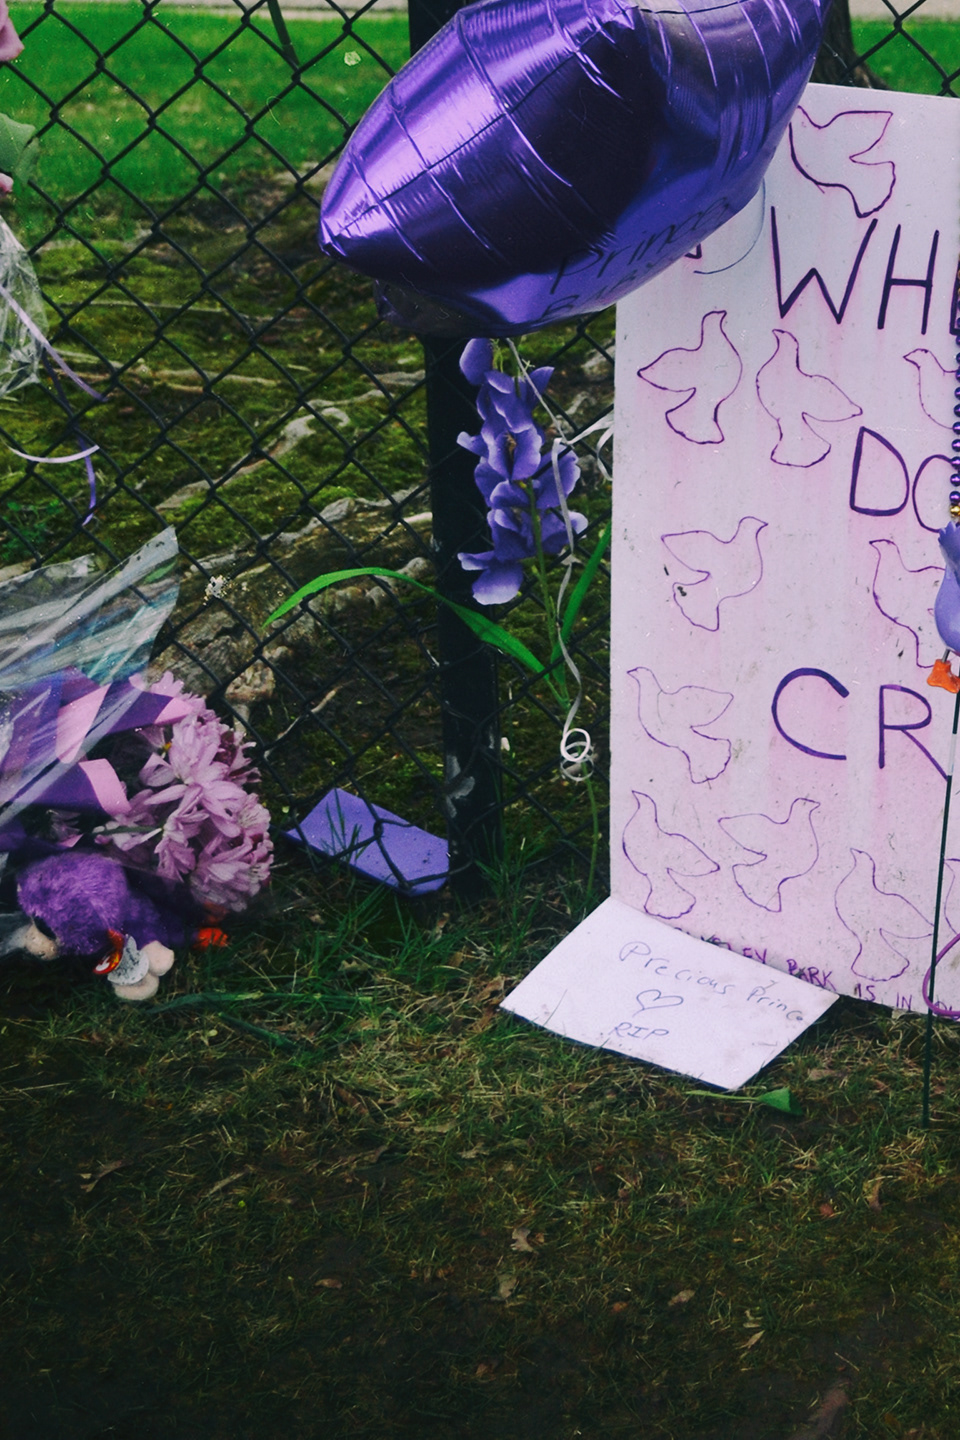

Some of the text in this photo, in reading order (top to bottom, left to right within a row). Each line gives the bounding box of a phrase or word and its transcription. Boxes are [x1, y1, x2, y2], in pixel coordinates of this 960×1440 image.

[618, 941, 735, 995] Precious
[746, 985, 805, 1022] Prince
[785, 958, 837, 992] PARK
[855, 982, 876, 1003] IS
[896, 992, 913, 1013] IN
[607, 1021, 671, 1041] RIP
